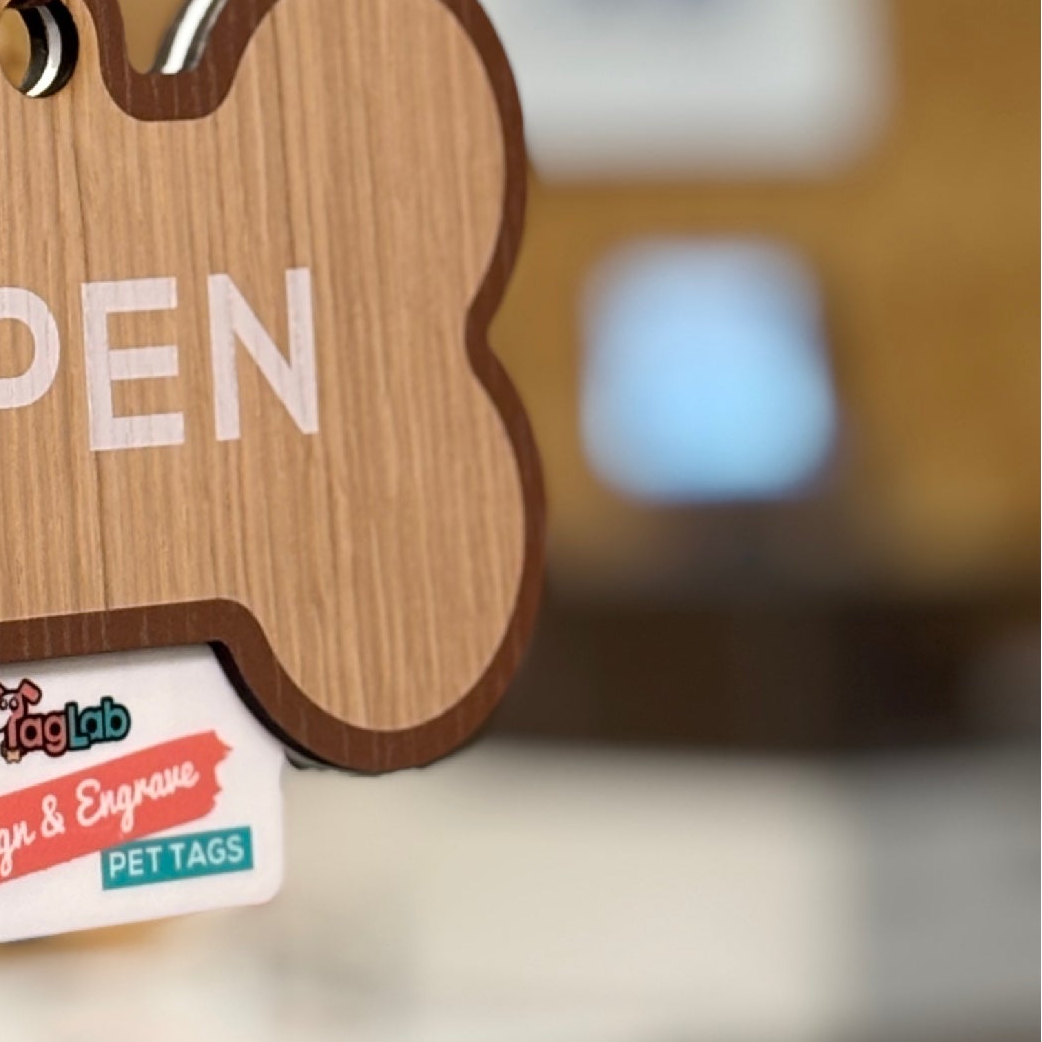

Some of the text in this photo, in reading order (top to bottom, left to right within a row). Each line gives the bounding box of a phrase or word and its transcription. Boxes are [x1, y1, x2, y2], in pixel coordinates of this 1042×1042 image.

[41, 794, 65, 838] &
[76, 759, 200, 833] Engrave
[108, 833, 245, 880] PET TAGS
